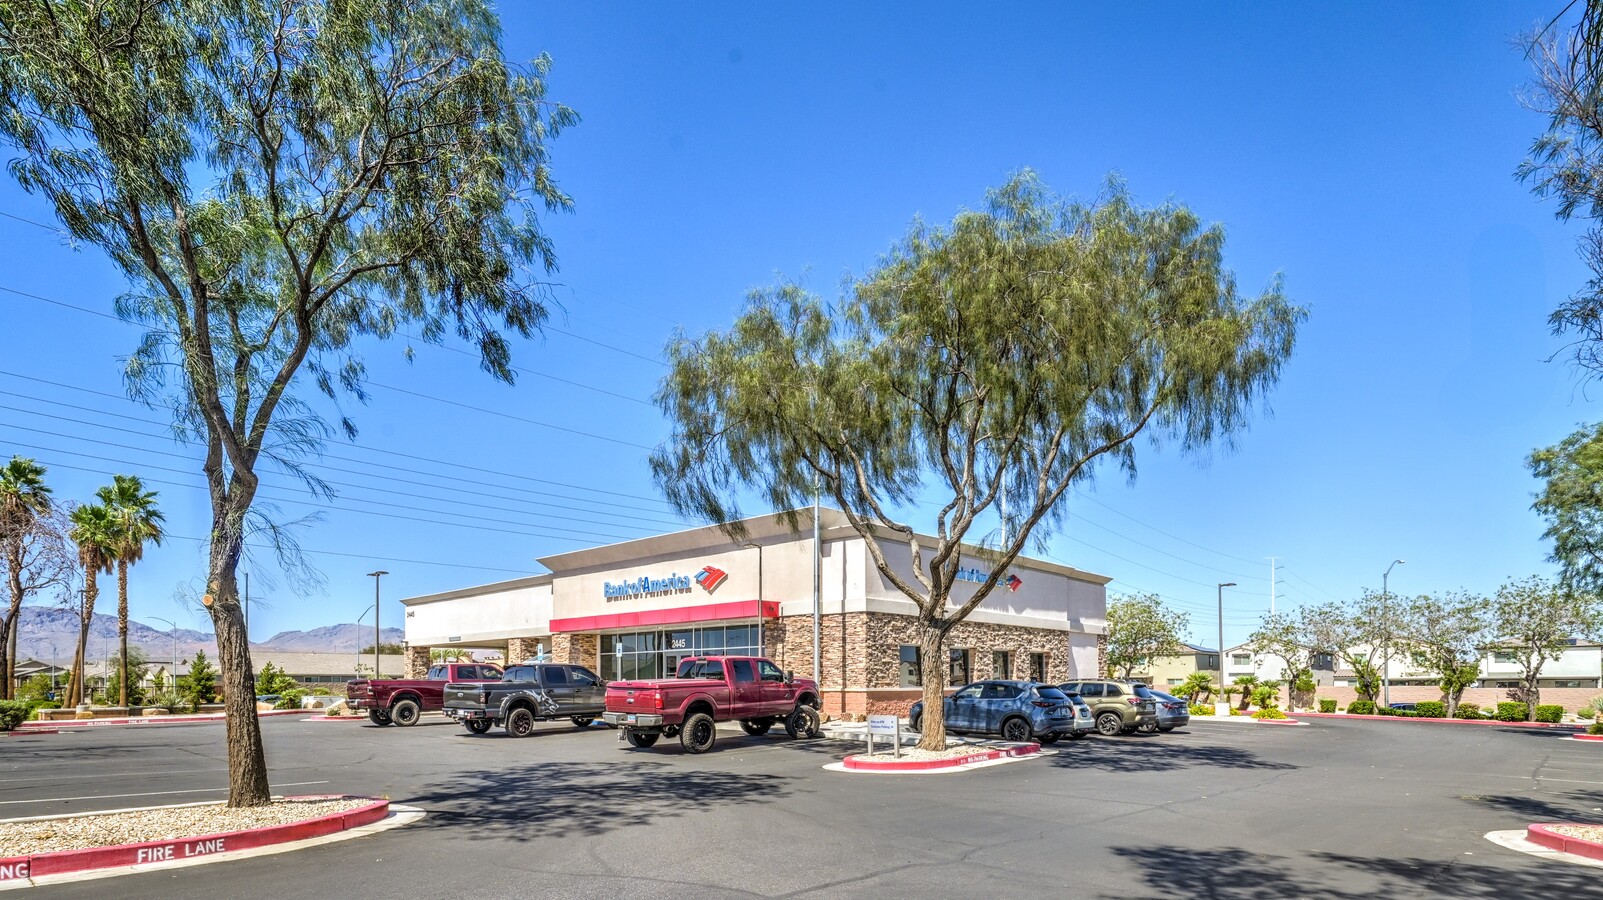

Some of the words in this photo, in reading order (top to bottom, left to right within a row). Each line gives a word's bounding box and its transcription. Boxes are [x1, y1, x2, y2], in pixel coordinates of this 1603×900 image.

[671, 639, 686, 648] 2445
[137, 845, 175, 863] FIRE
[185, 838, 225, 857] LANE
